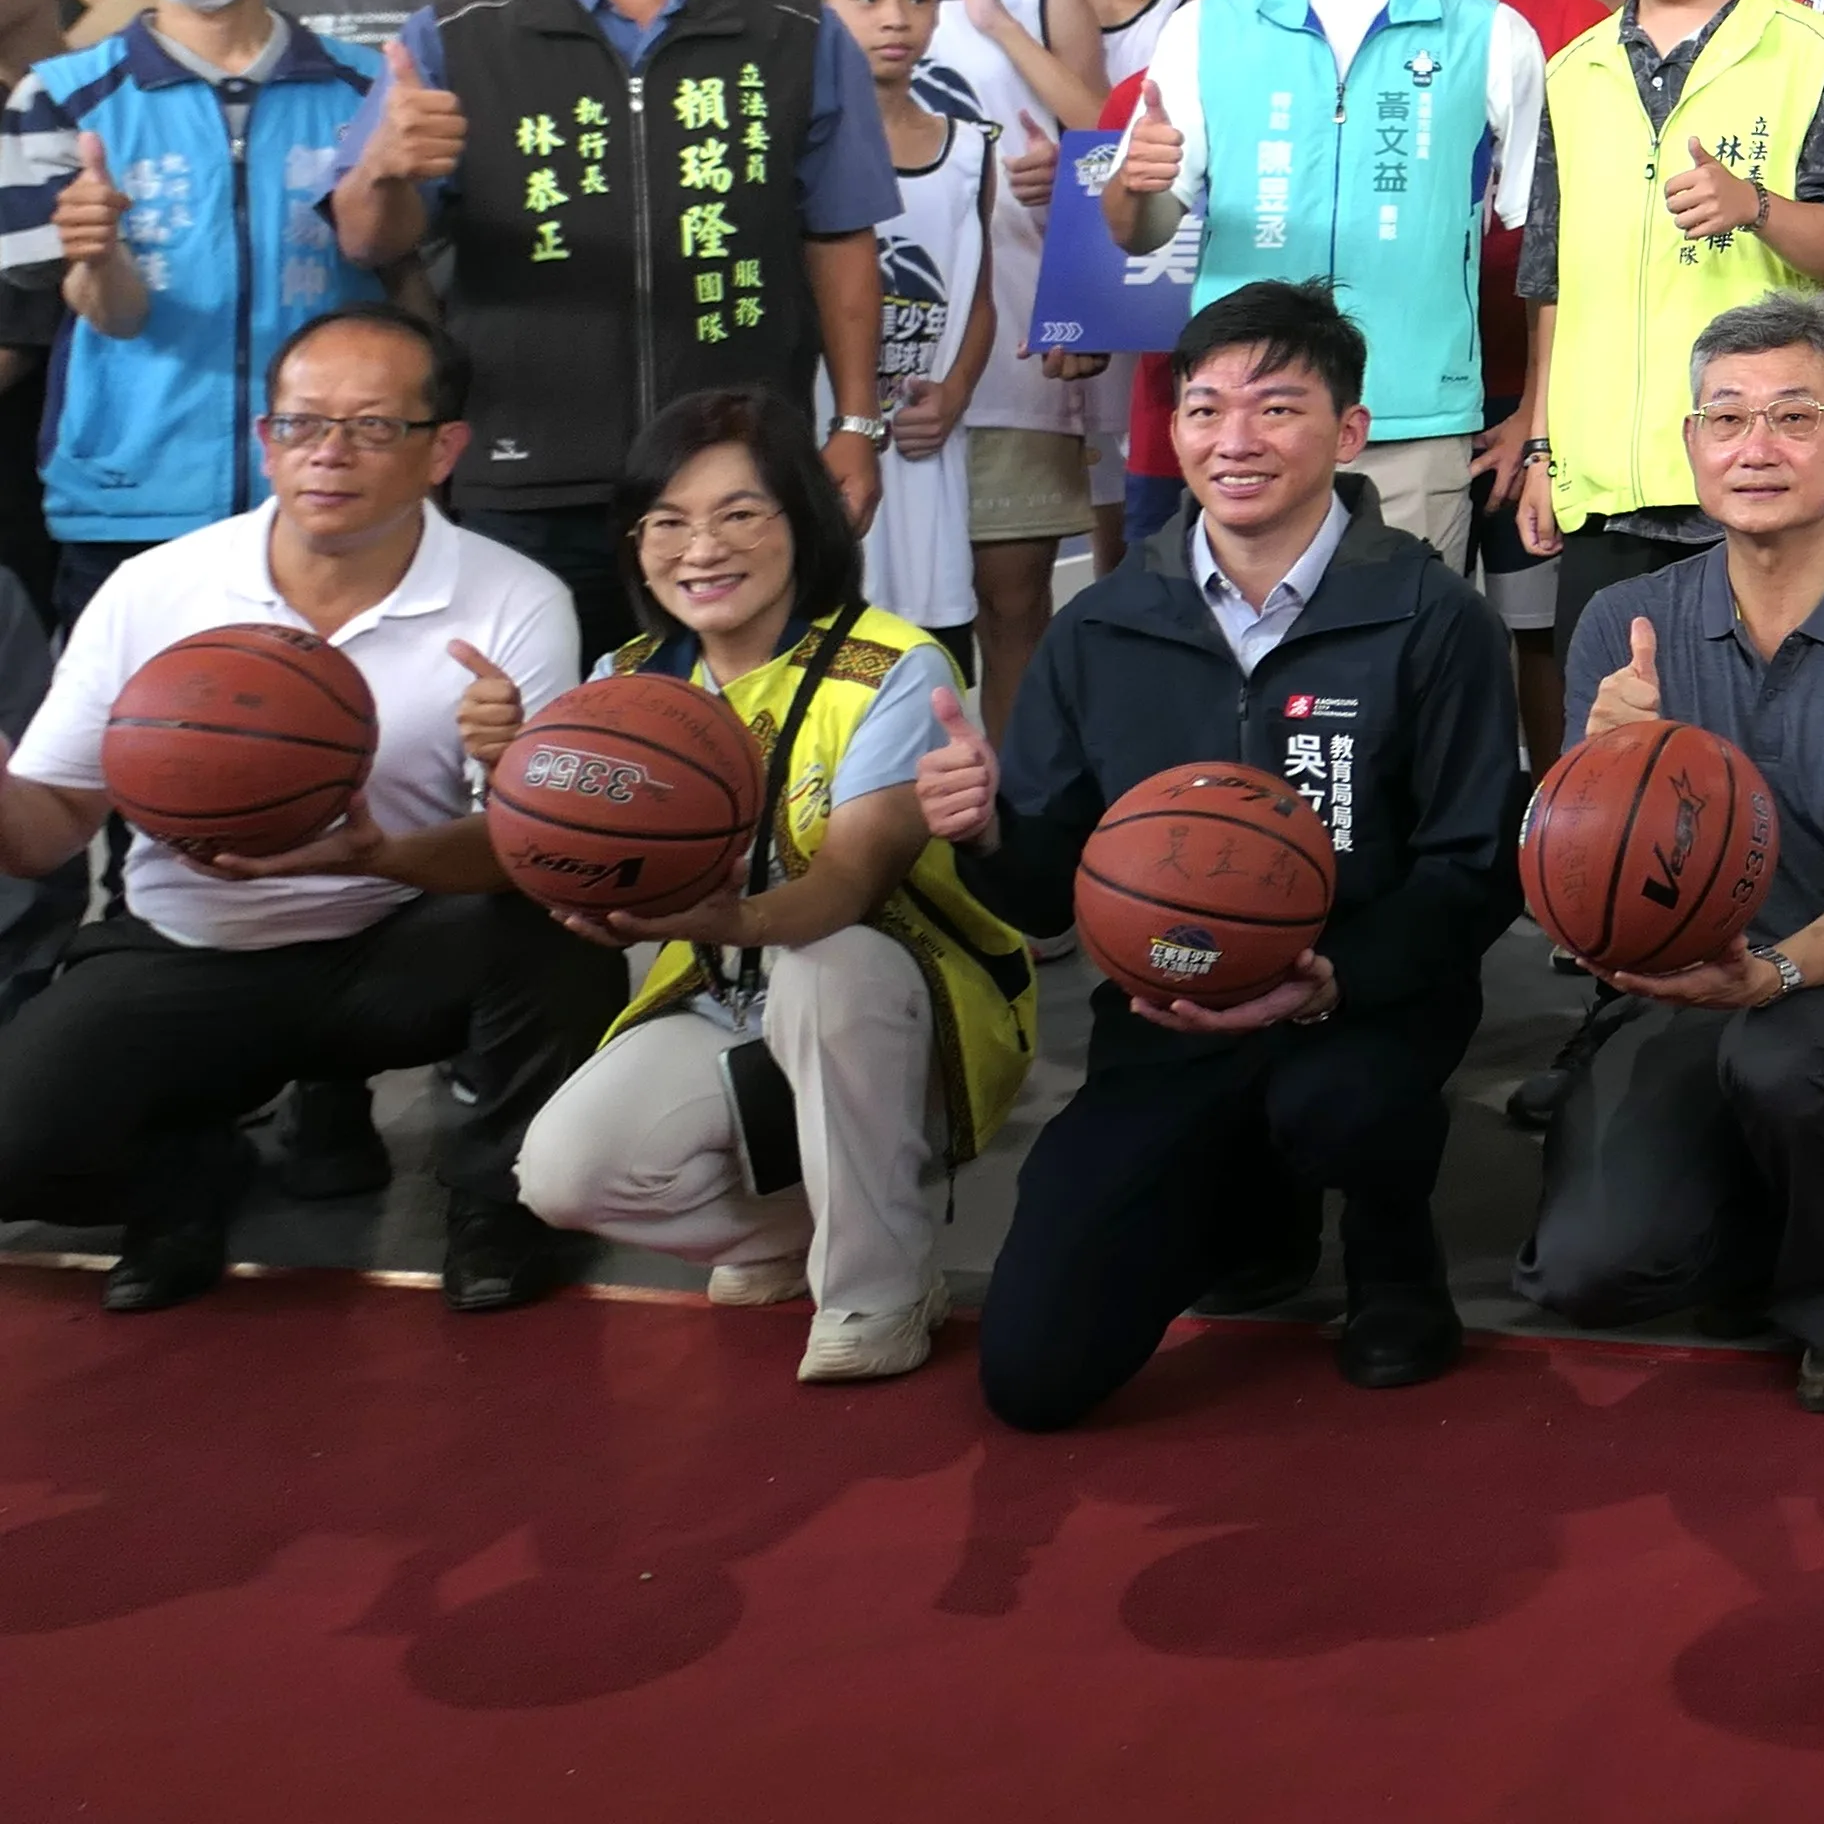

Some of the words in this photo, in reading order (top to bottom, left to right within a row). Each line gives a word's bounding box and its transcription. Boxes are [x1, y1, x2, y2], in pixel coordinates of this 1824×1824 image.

[572, 96, 610, 195] 執行長
[672, 77, 738, 258] 賴瑞隆
[736, 63, 771, 185] 立法委員
[1373, 91, 1410, 193] 黃文益
[694, 272, 729, 344] 團隊
[732, 259, 765, 327] 服務
[524, 750, 641, 804] 3356
[1329, 734, 1354, 852] 教育局局長
